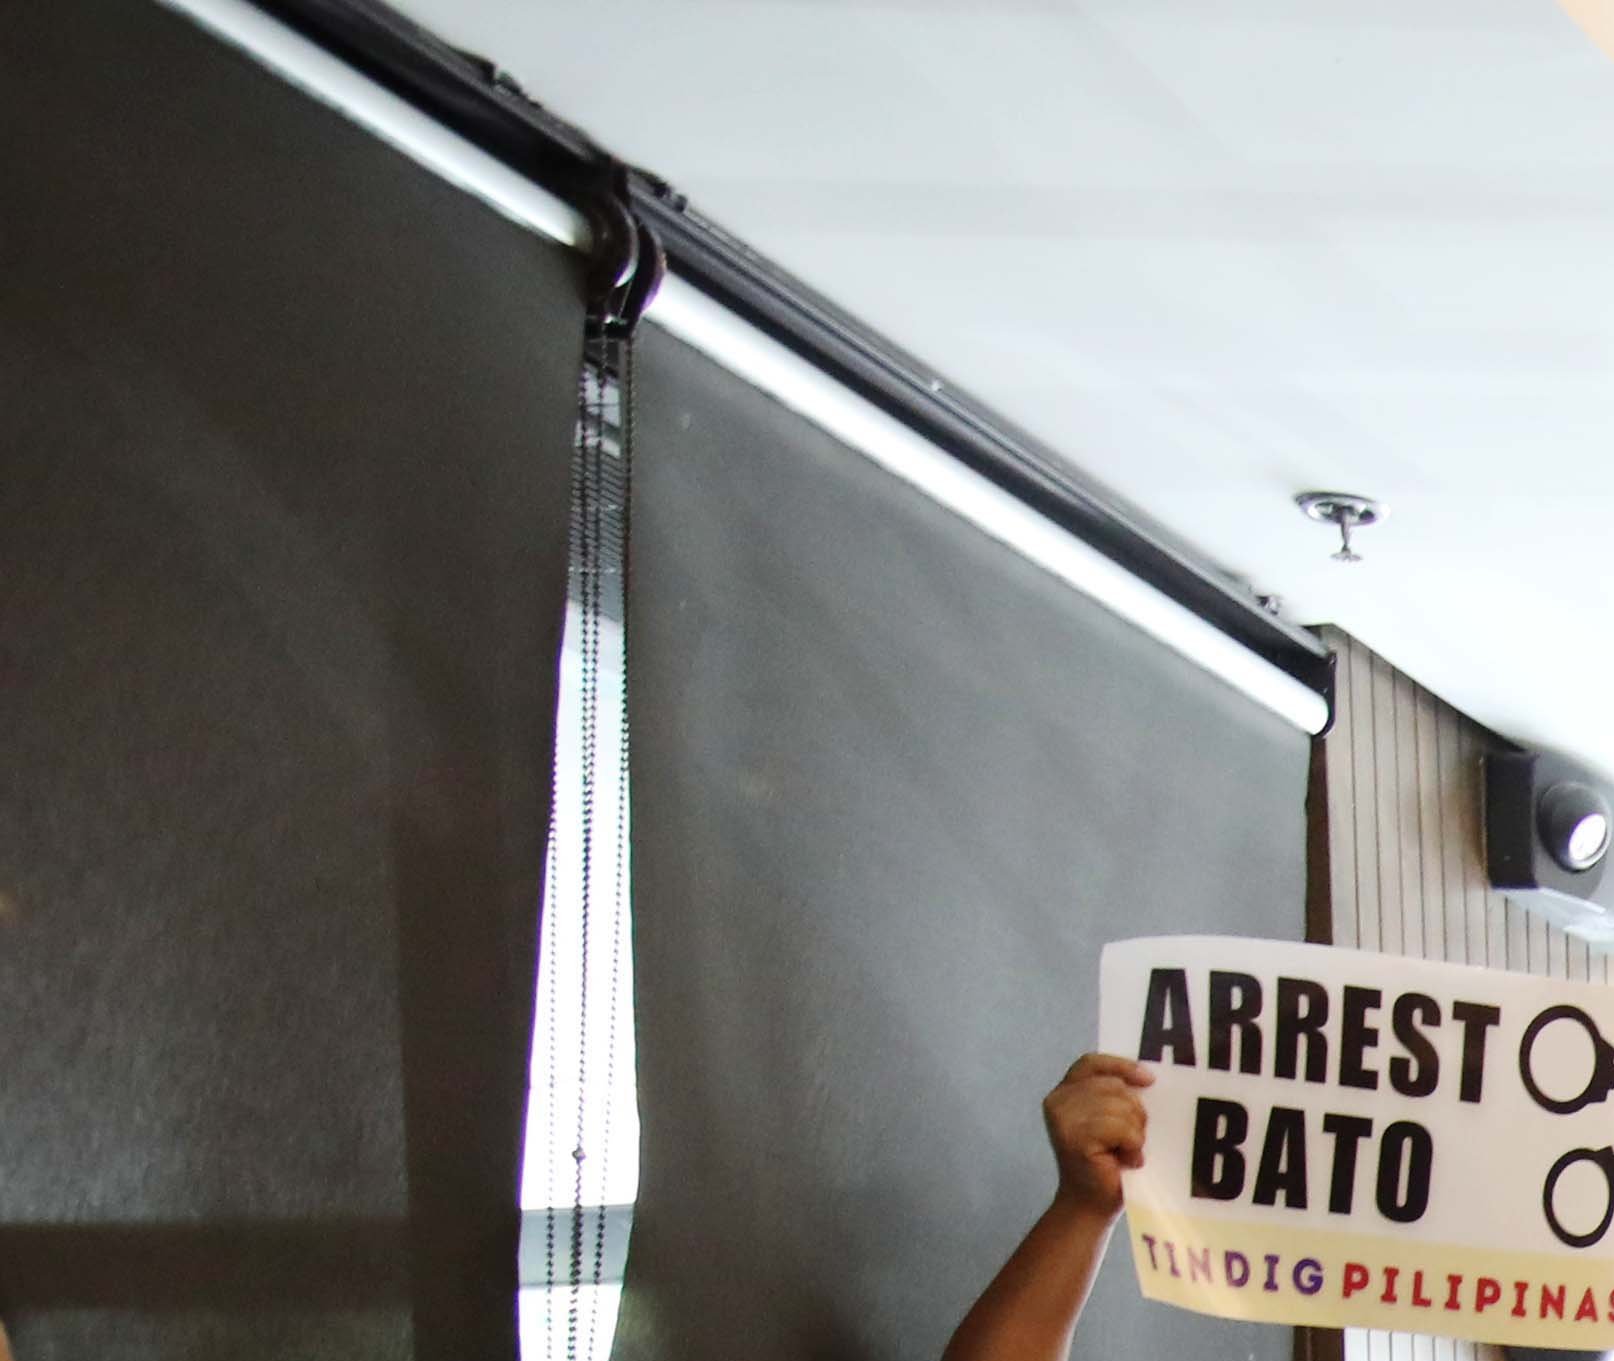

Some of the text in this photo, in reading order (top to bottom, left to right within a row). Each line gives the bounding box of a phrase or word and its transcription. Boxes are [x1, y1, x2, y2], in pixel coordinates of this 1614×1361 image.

[1137, 968, 1501, 1104] ARREST
[1190, 1097, 1434, 1224] BATO
[1141, 1233, 1325, 1297] TINDIG
